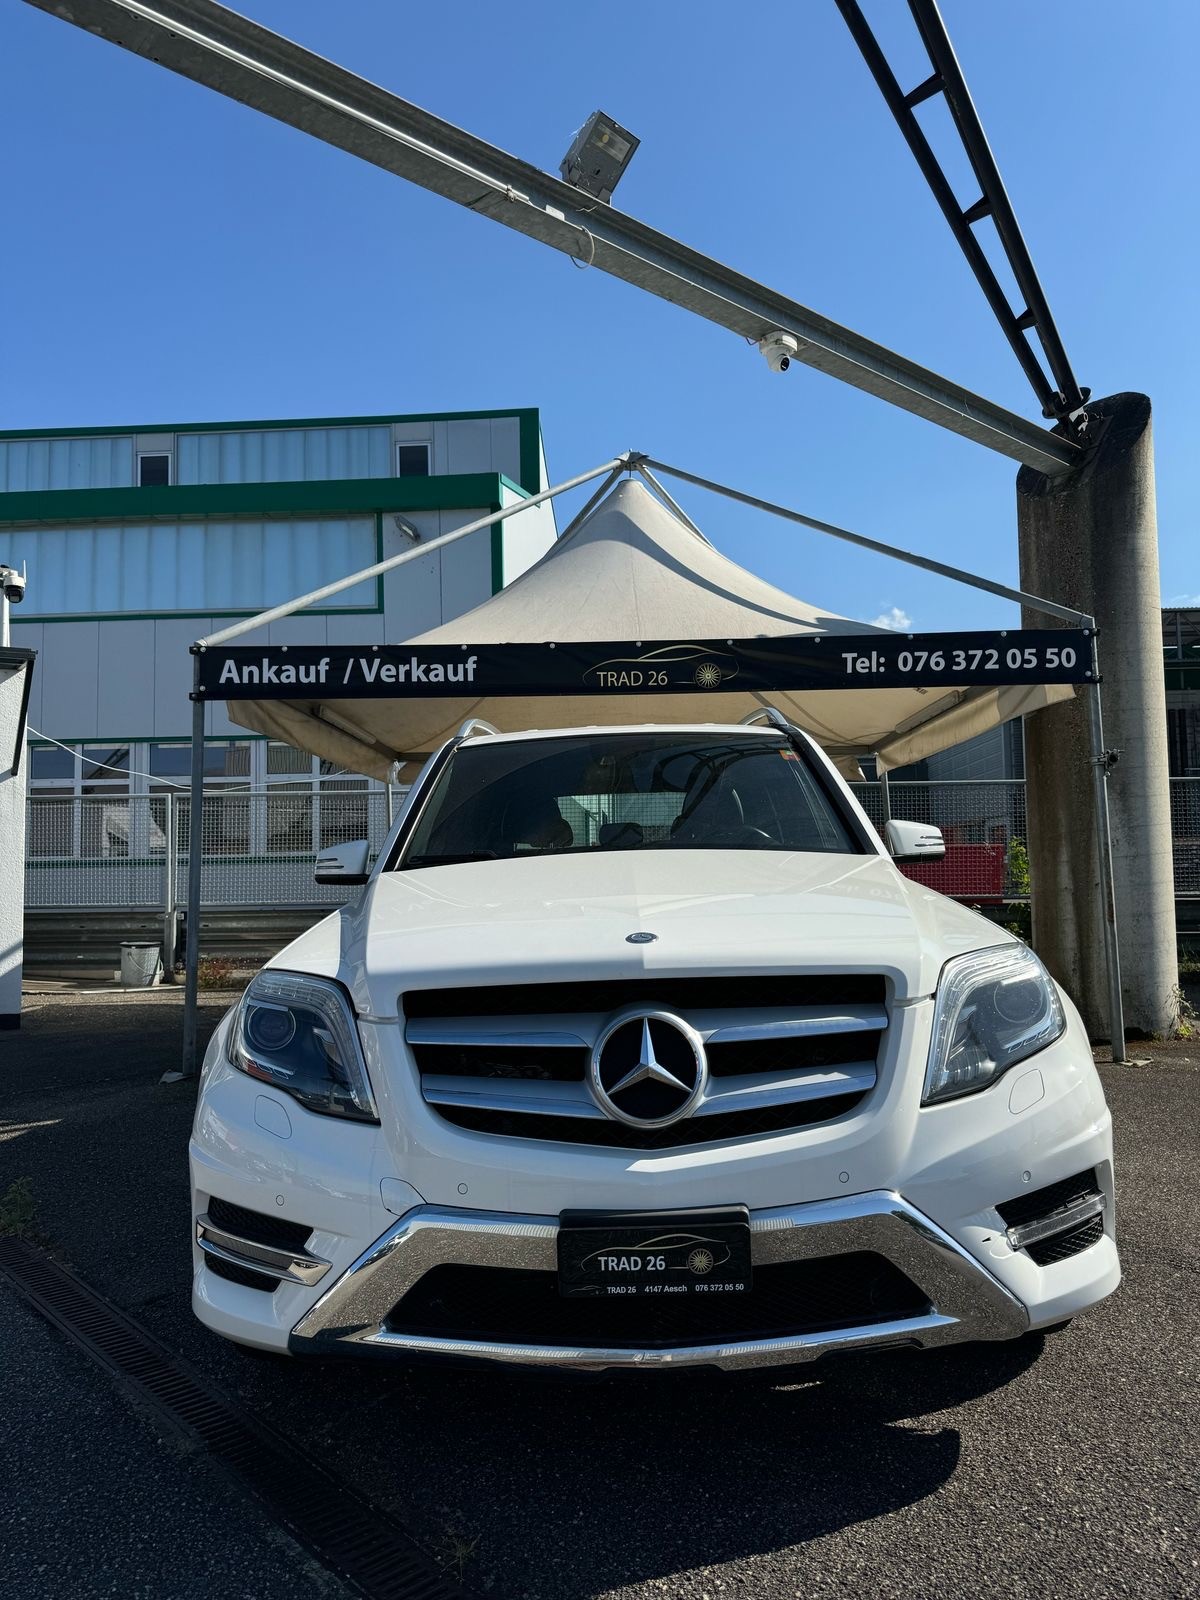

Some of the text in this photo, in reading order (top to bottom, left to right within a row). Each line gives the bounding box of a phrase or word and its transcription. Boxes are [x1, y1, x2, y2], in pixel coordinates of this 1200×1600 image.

[842, 647, 1076, 673] Tel: 076 372 05 50
[219, 656, 478, 684] Ankauf / Verkauf
[597, 670, 668, 687] TRAD 26
[597, 1255, 666, 1271] TRAD 26
[607, 1283, 744, 1294] TRAD 26 4147 Aesch 076 372 05 50
